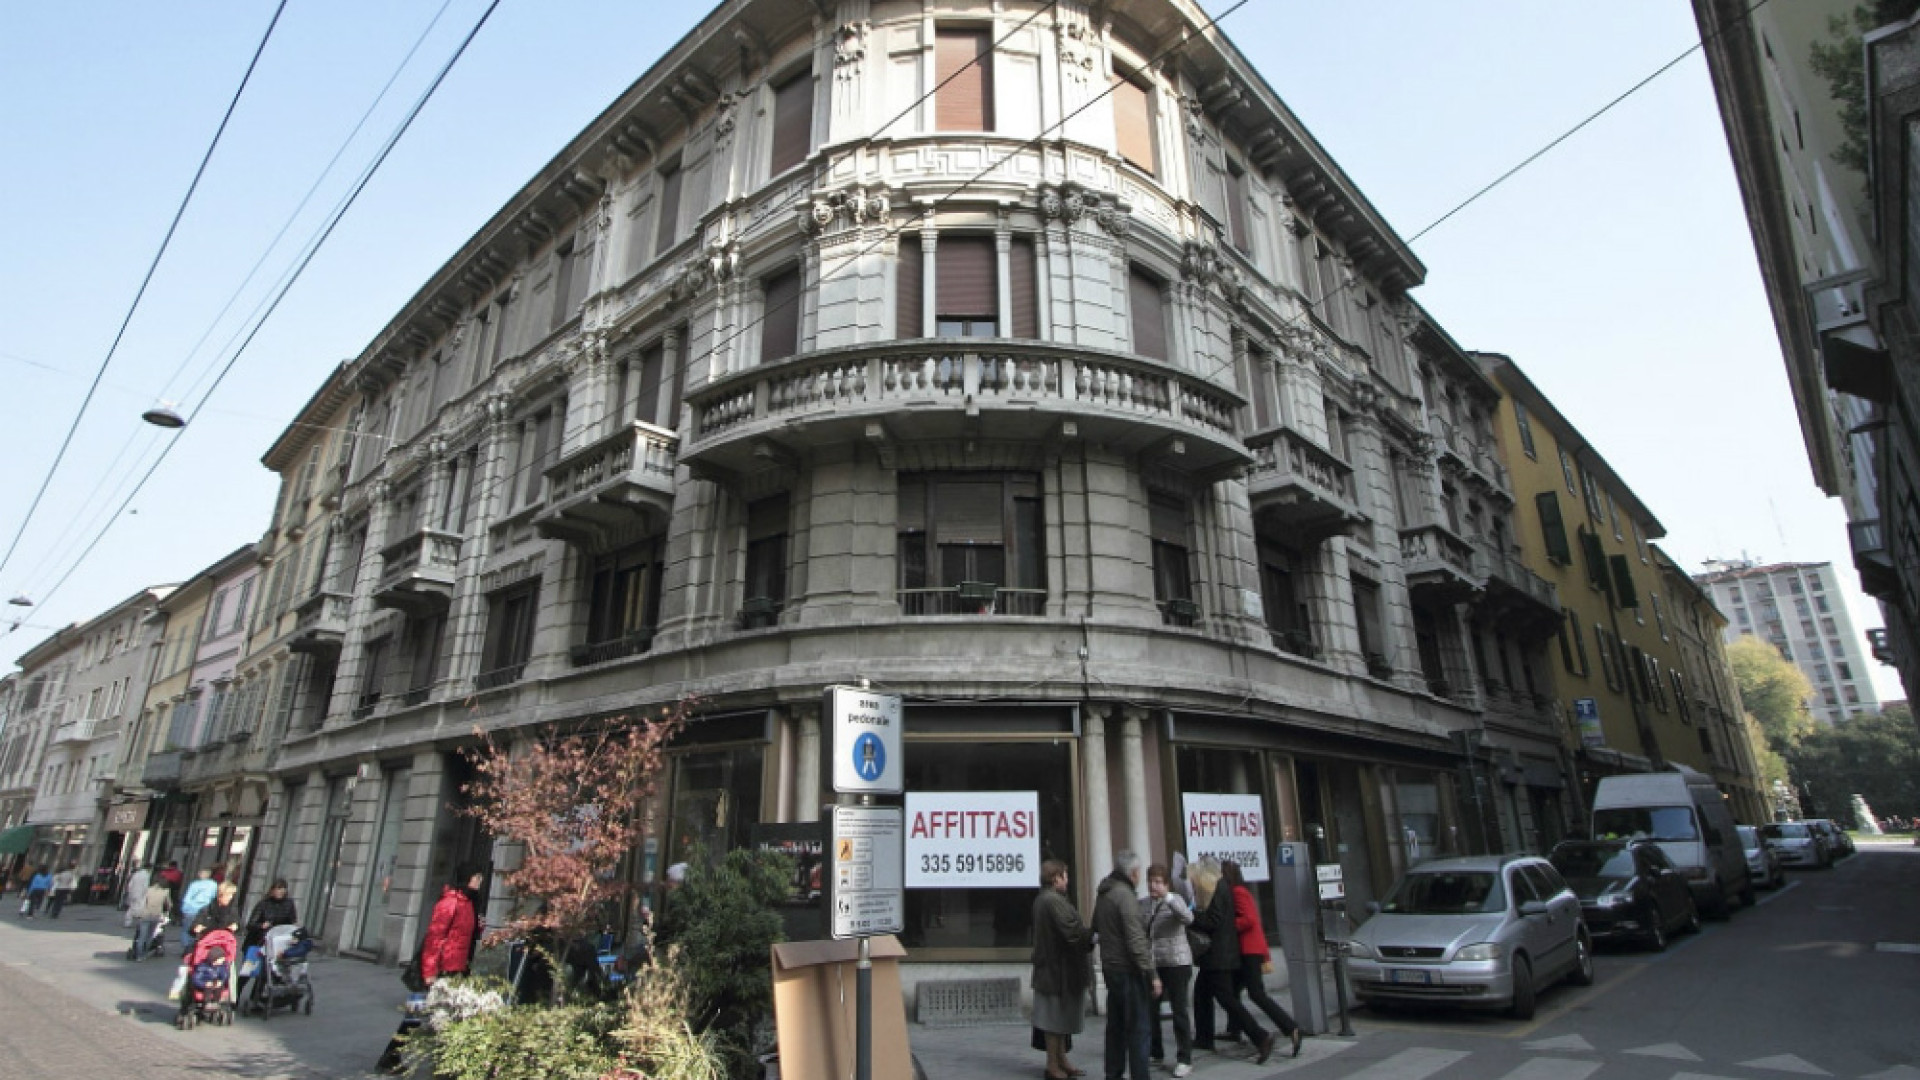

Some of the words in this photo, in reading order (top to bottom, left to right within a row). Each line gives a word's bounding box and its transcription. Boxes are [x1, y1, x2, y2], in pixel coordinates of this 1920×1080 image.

[910, 810, 1035, 839] AFFITTASI
[1189, 811, 1262, 837] AFFITTASI
[921, 853, 951, 873] 335
[955, 853, 1025, 873] 5915896
[1282, 847, 1292, 864] P
